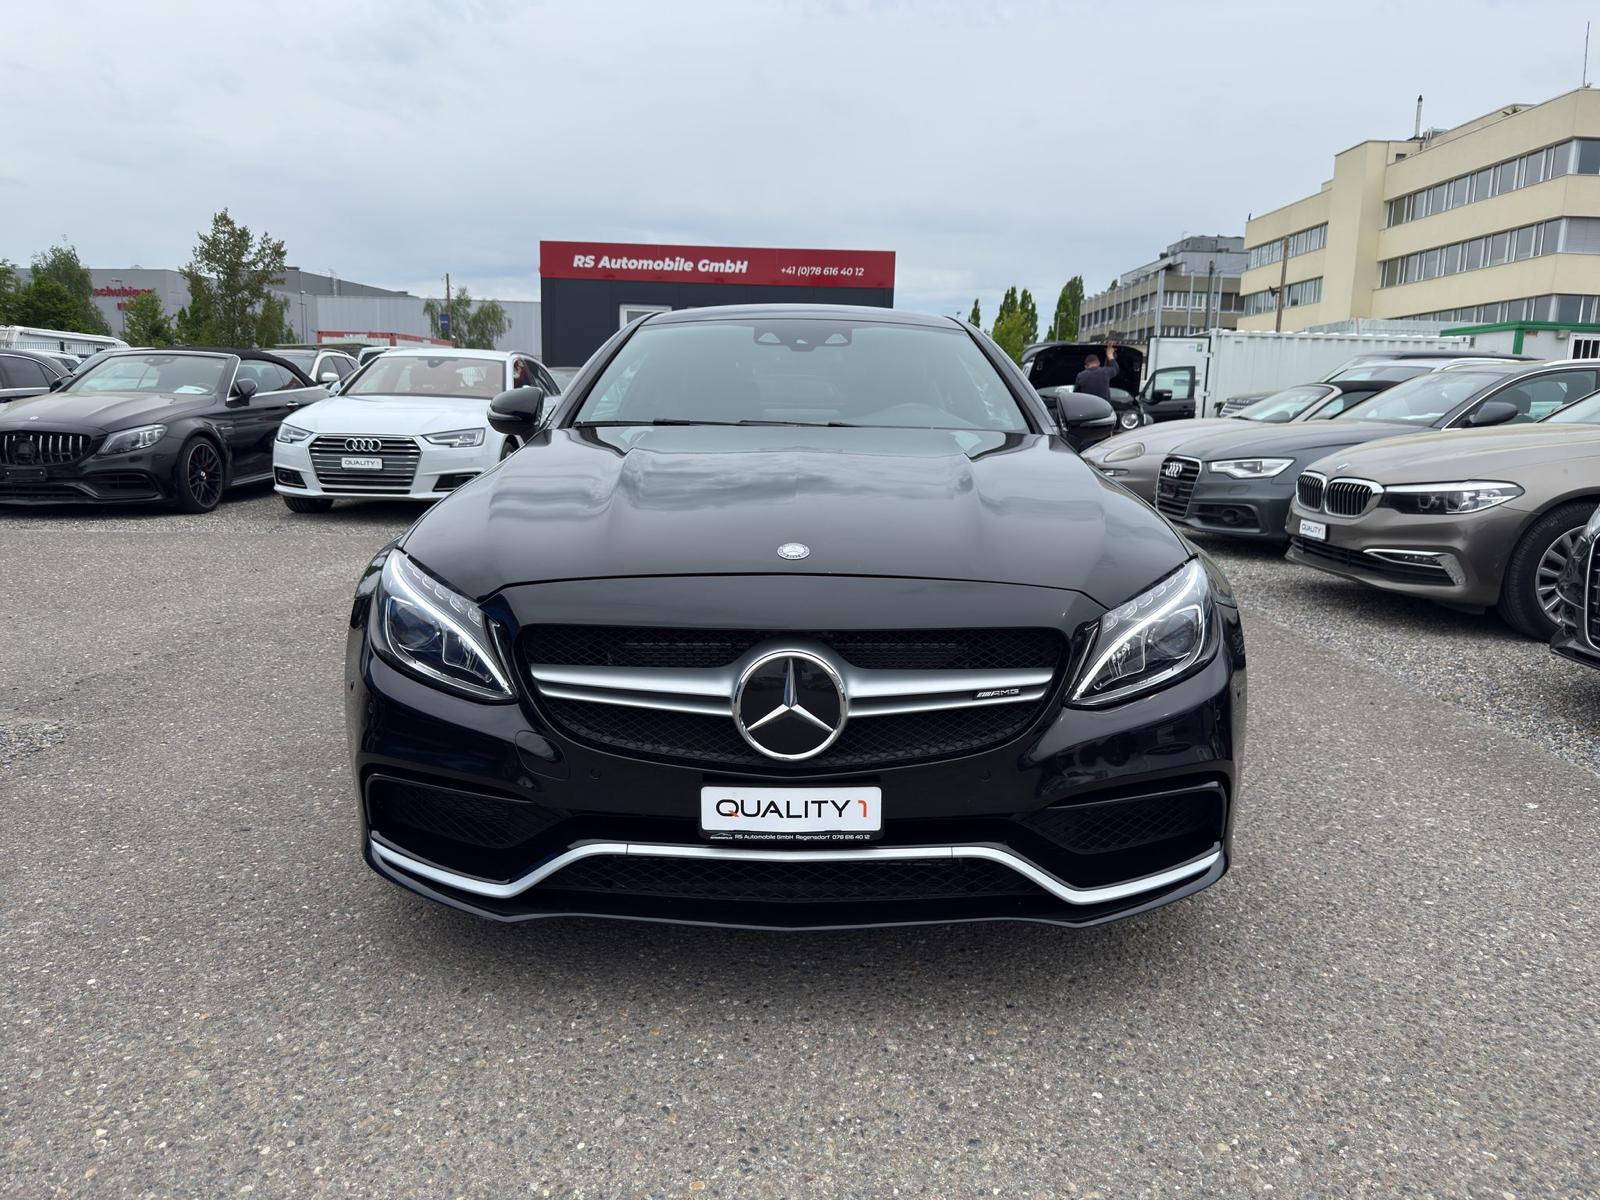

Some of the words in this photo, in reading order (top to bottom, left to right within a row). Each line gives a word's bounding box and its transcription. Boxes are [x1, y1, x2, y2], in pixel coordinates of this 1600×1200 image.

[573, 255, 595, 268] RS
[597, 255, 694, 272] Automobile
[698, 258, 748, 274] GmbH
[781, 266, 796, 276] +41
[797, 266, 822, 278] (0)78
[823, 266, 838, 277] 616
[840, 267, 853, 277] 40
[854, 267, 865, 277] 12
[715, 799, 851, 819] QUALITY
[857, 800, 868, 818] 1
